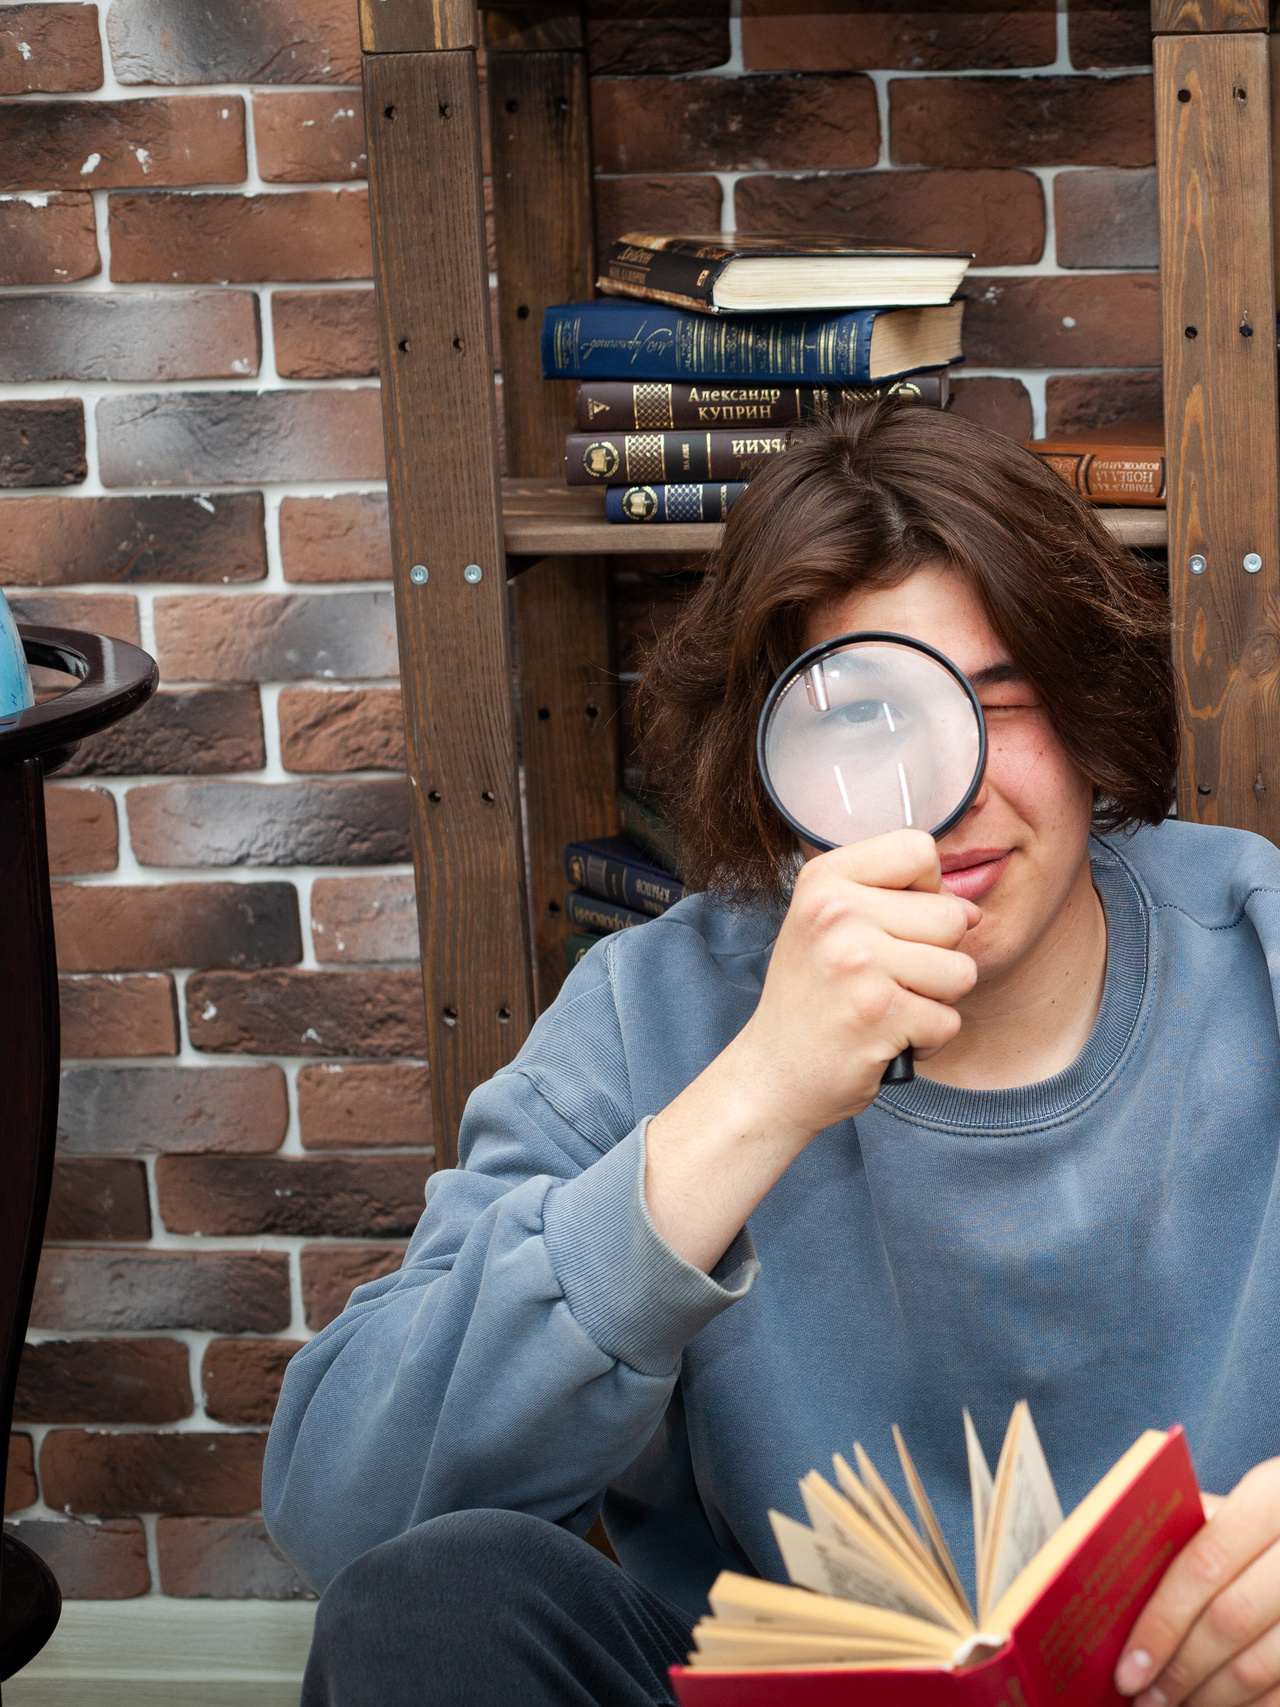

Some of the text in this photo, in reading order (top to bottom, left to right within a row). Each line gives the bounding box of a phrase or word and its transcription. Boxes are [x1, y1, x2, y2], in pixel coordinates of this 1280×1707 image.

[688, 387, 781, 404] Александр
[698, 405, 772, 421] КУПРИН
[1096, 471, 1154, 483] НОВЕЛЛА
